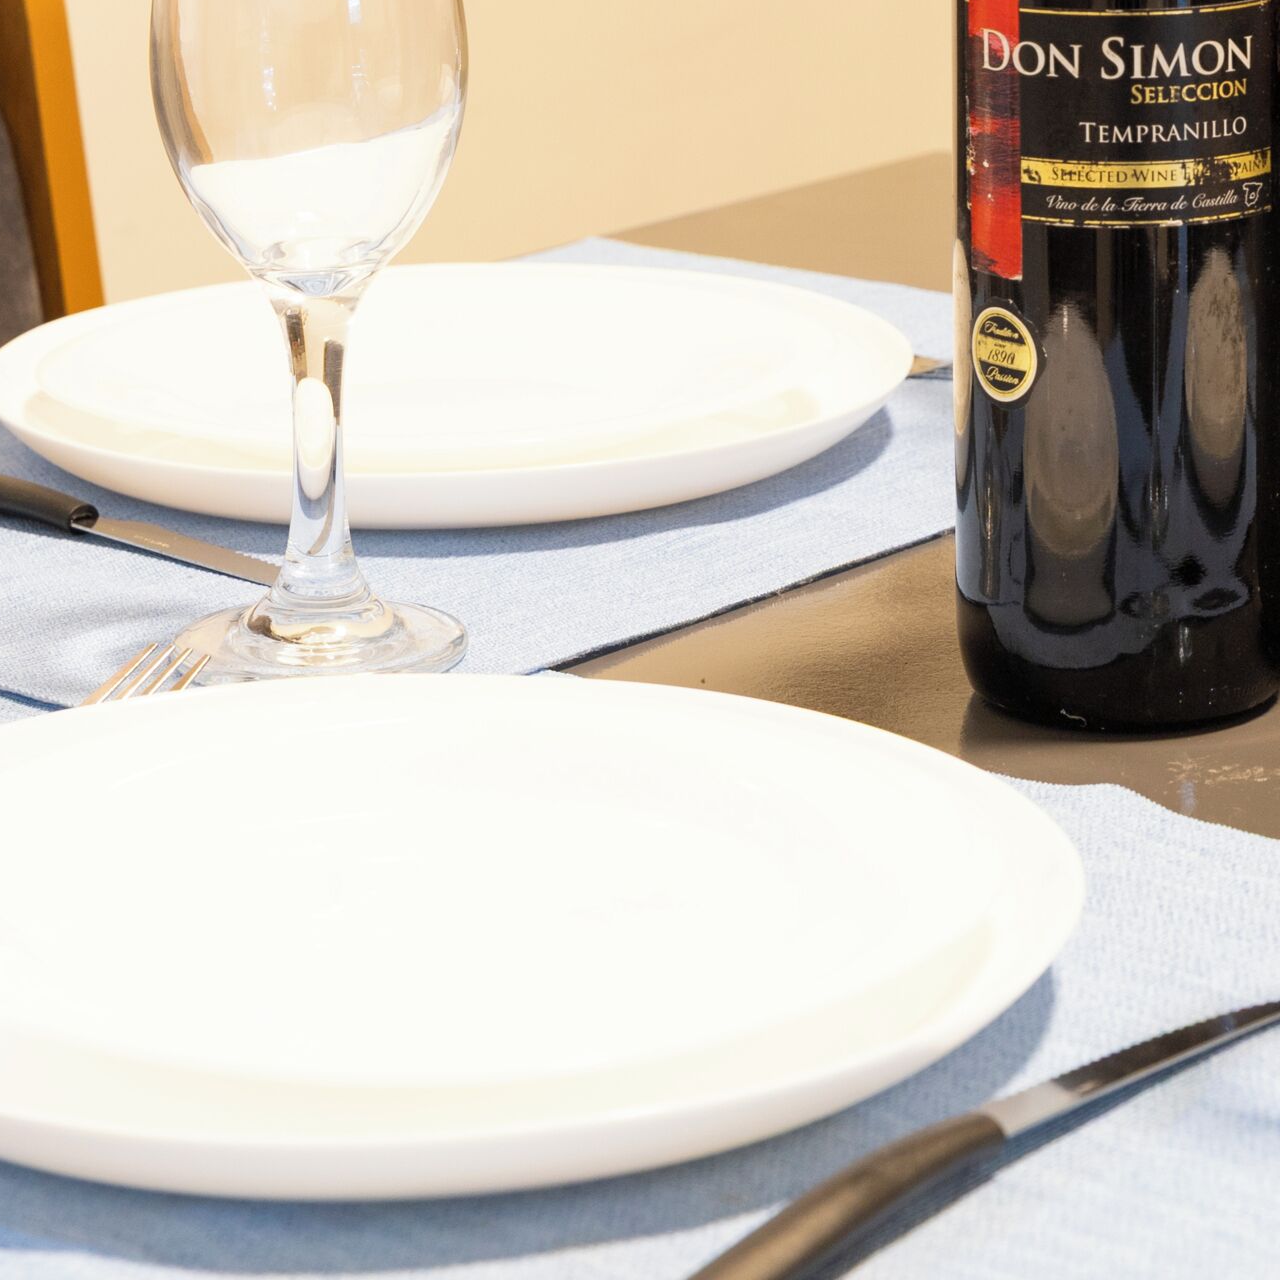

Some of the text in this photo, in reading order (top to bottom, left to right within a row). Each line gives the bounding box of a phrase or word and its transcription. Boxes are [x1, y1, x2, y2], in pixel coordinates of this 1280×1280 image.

[980, 27, 1253, 80] DON SIMON
[1130, 78, 1248, 105] SELECCION
[1078, 116, 1247, 144] TEMPRANILLO
[1051, 166, 1128, 184] SELECTED
[1133, 168, 1178, 183] WINE
[1045, 188, 1238, 212] Vino de la Tierra de Castilla
